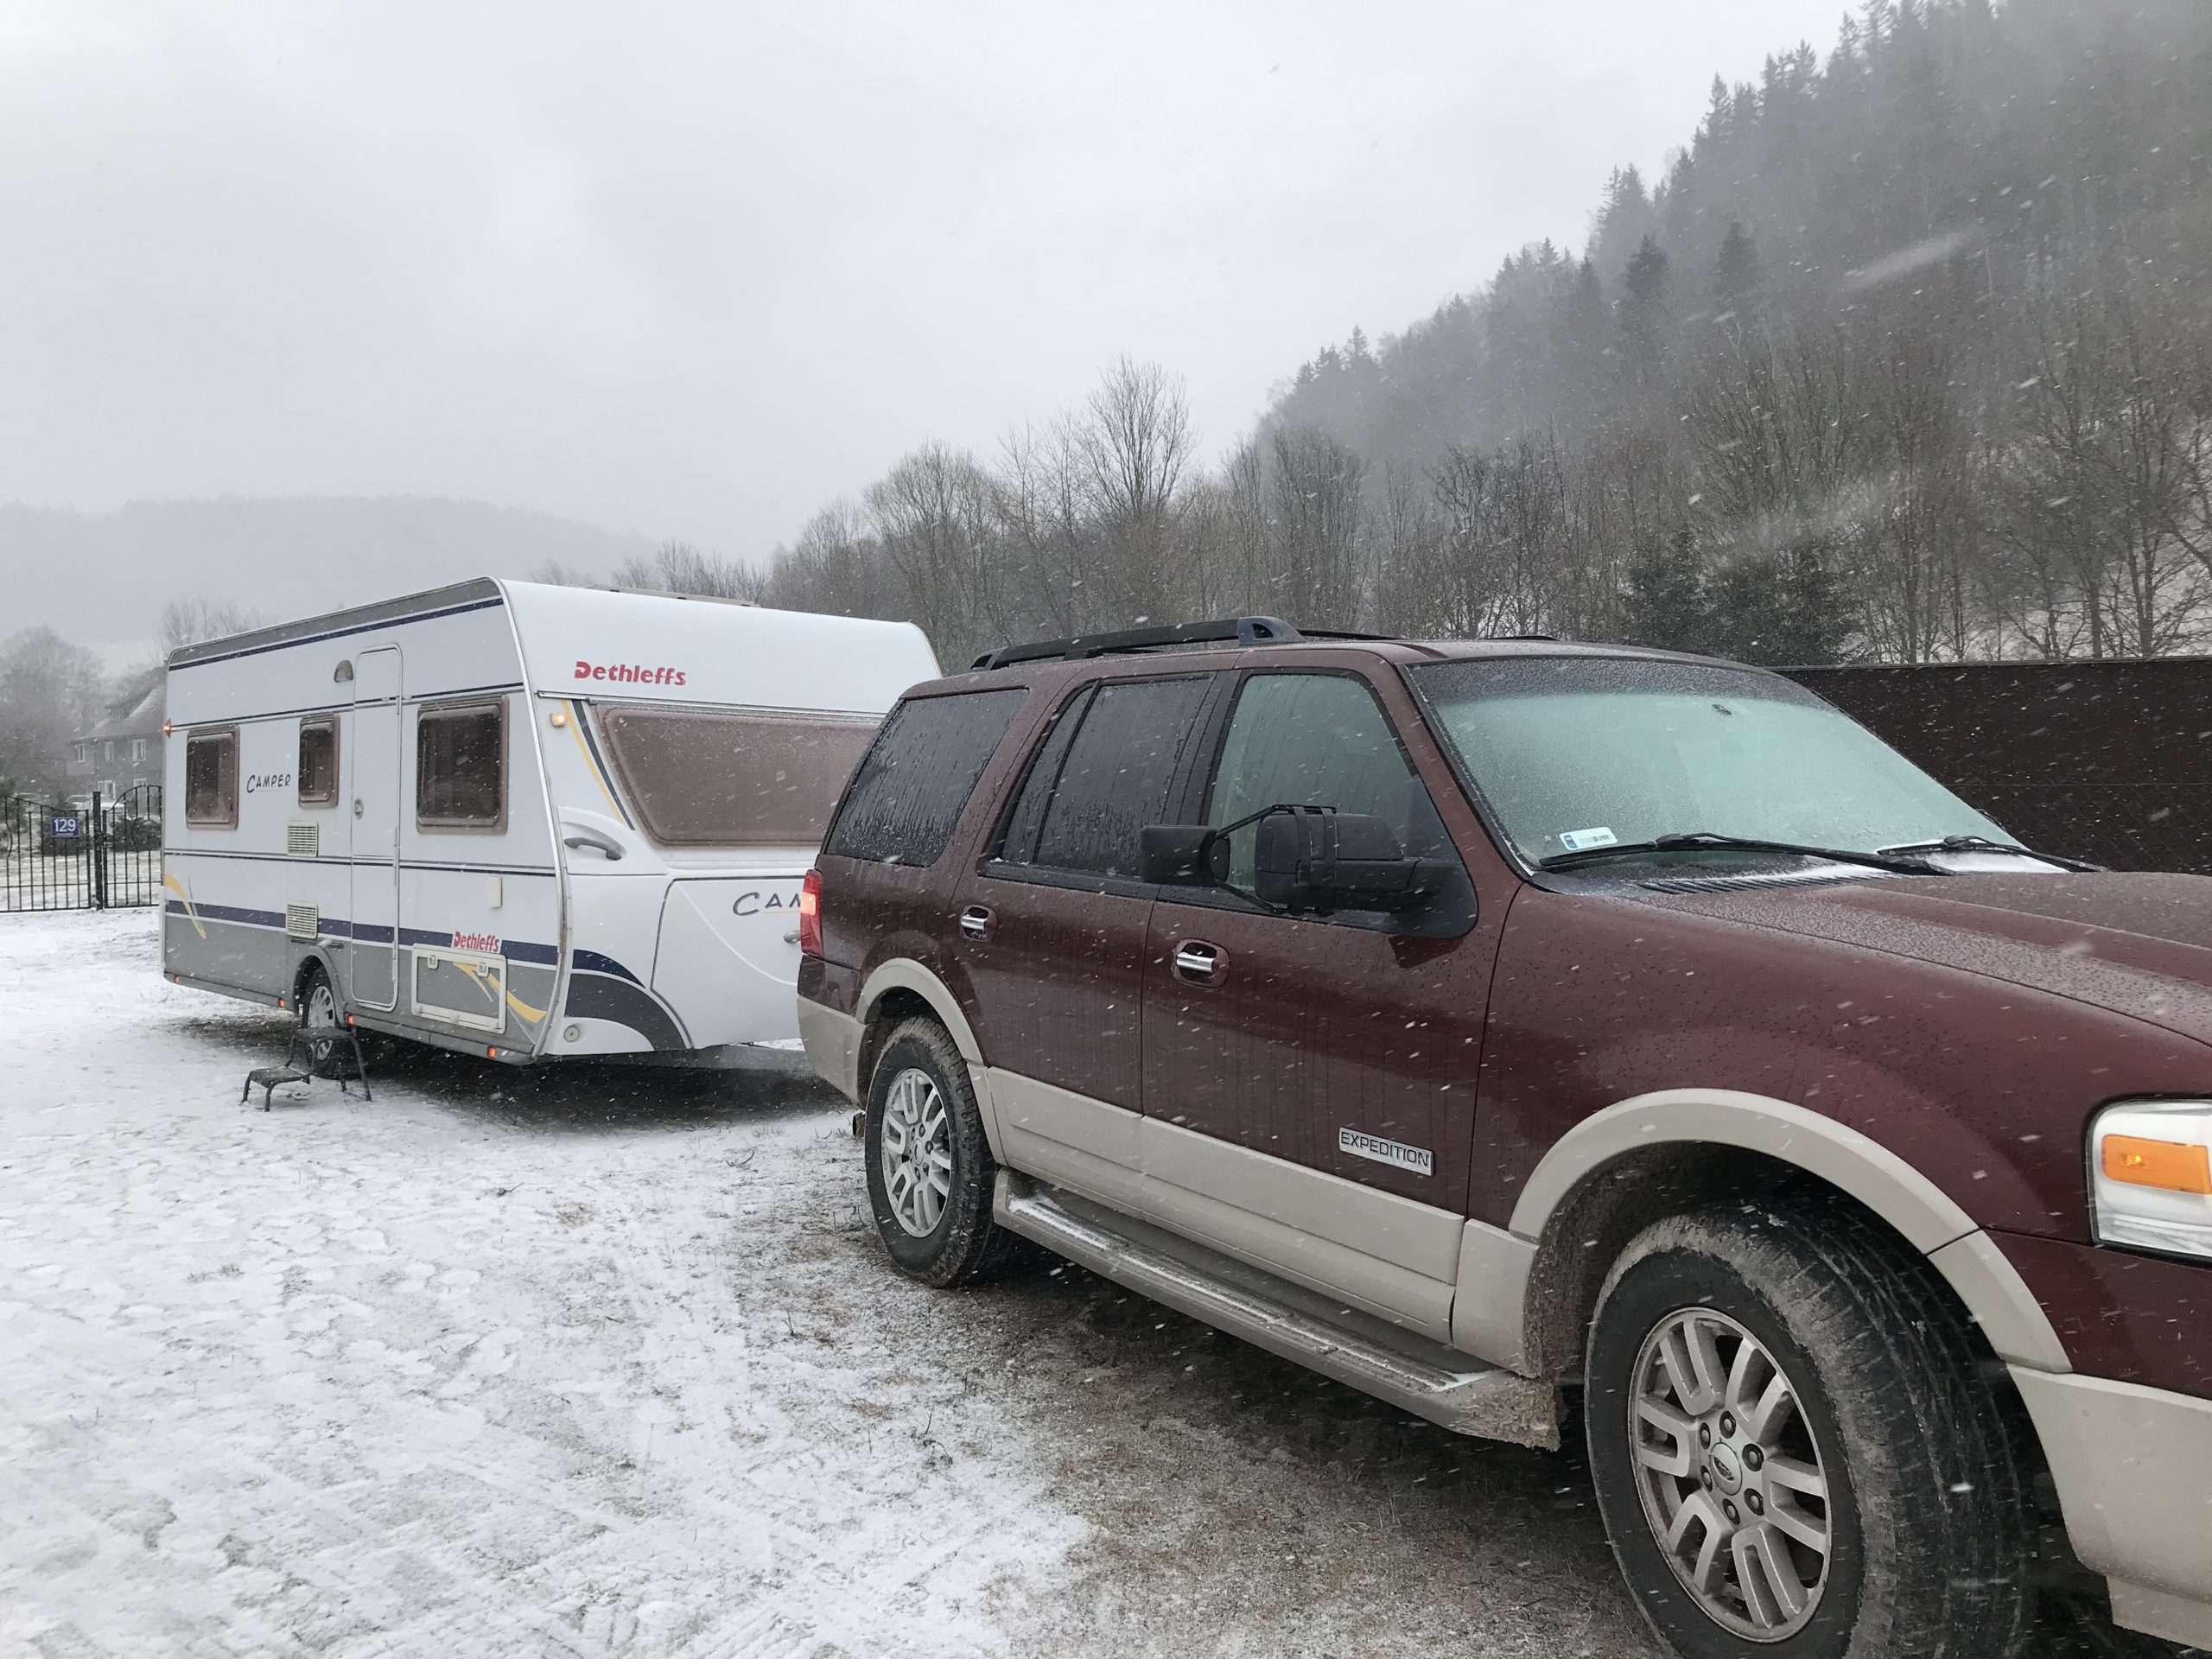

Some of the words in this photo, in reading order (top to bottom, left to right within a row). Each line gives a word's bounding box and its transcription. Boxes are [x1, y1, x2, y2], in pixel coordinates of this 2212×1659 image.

[574, 661, 687, 686] Dethleffs
[246, 774, 291, 793] CAMPER
[54, 818, 76, 832] 129
[454, 931, 499, 952] Dethleffs
[1341, 1131, 1429, 1166] EXPEDITION
